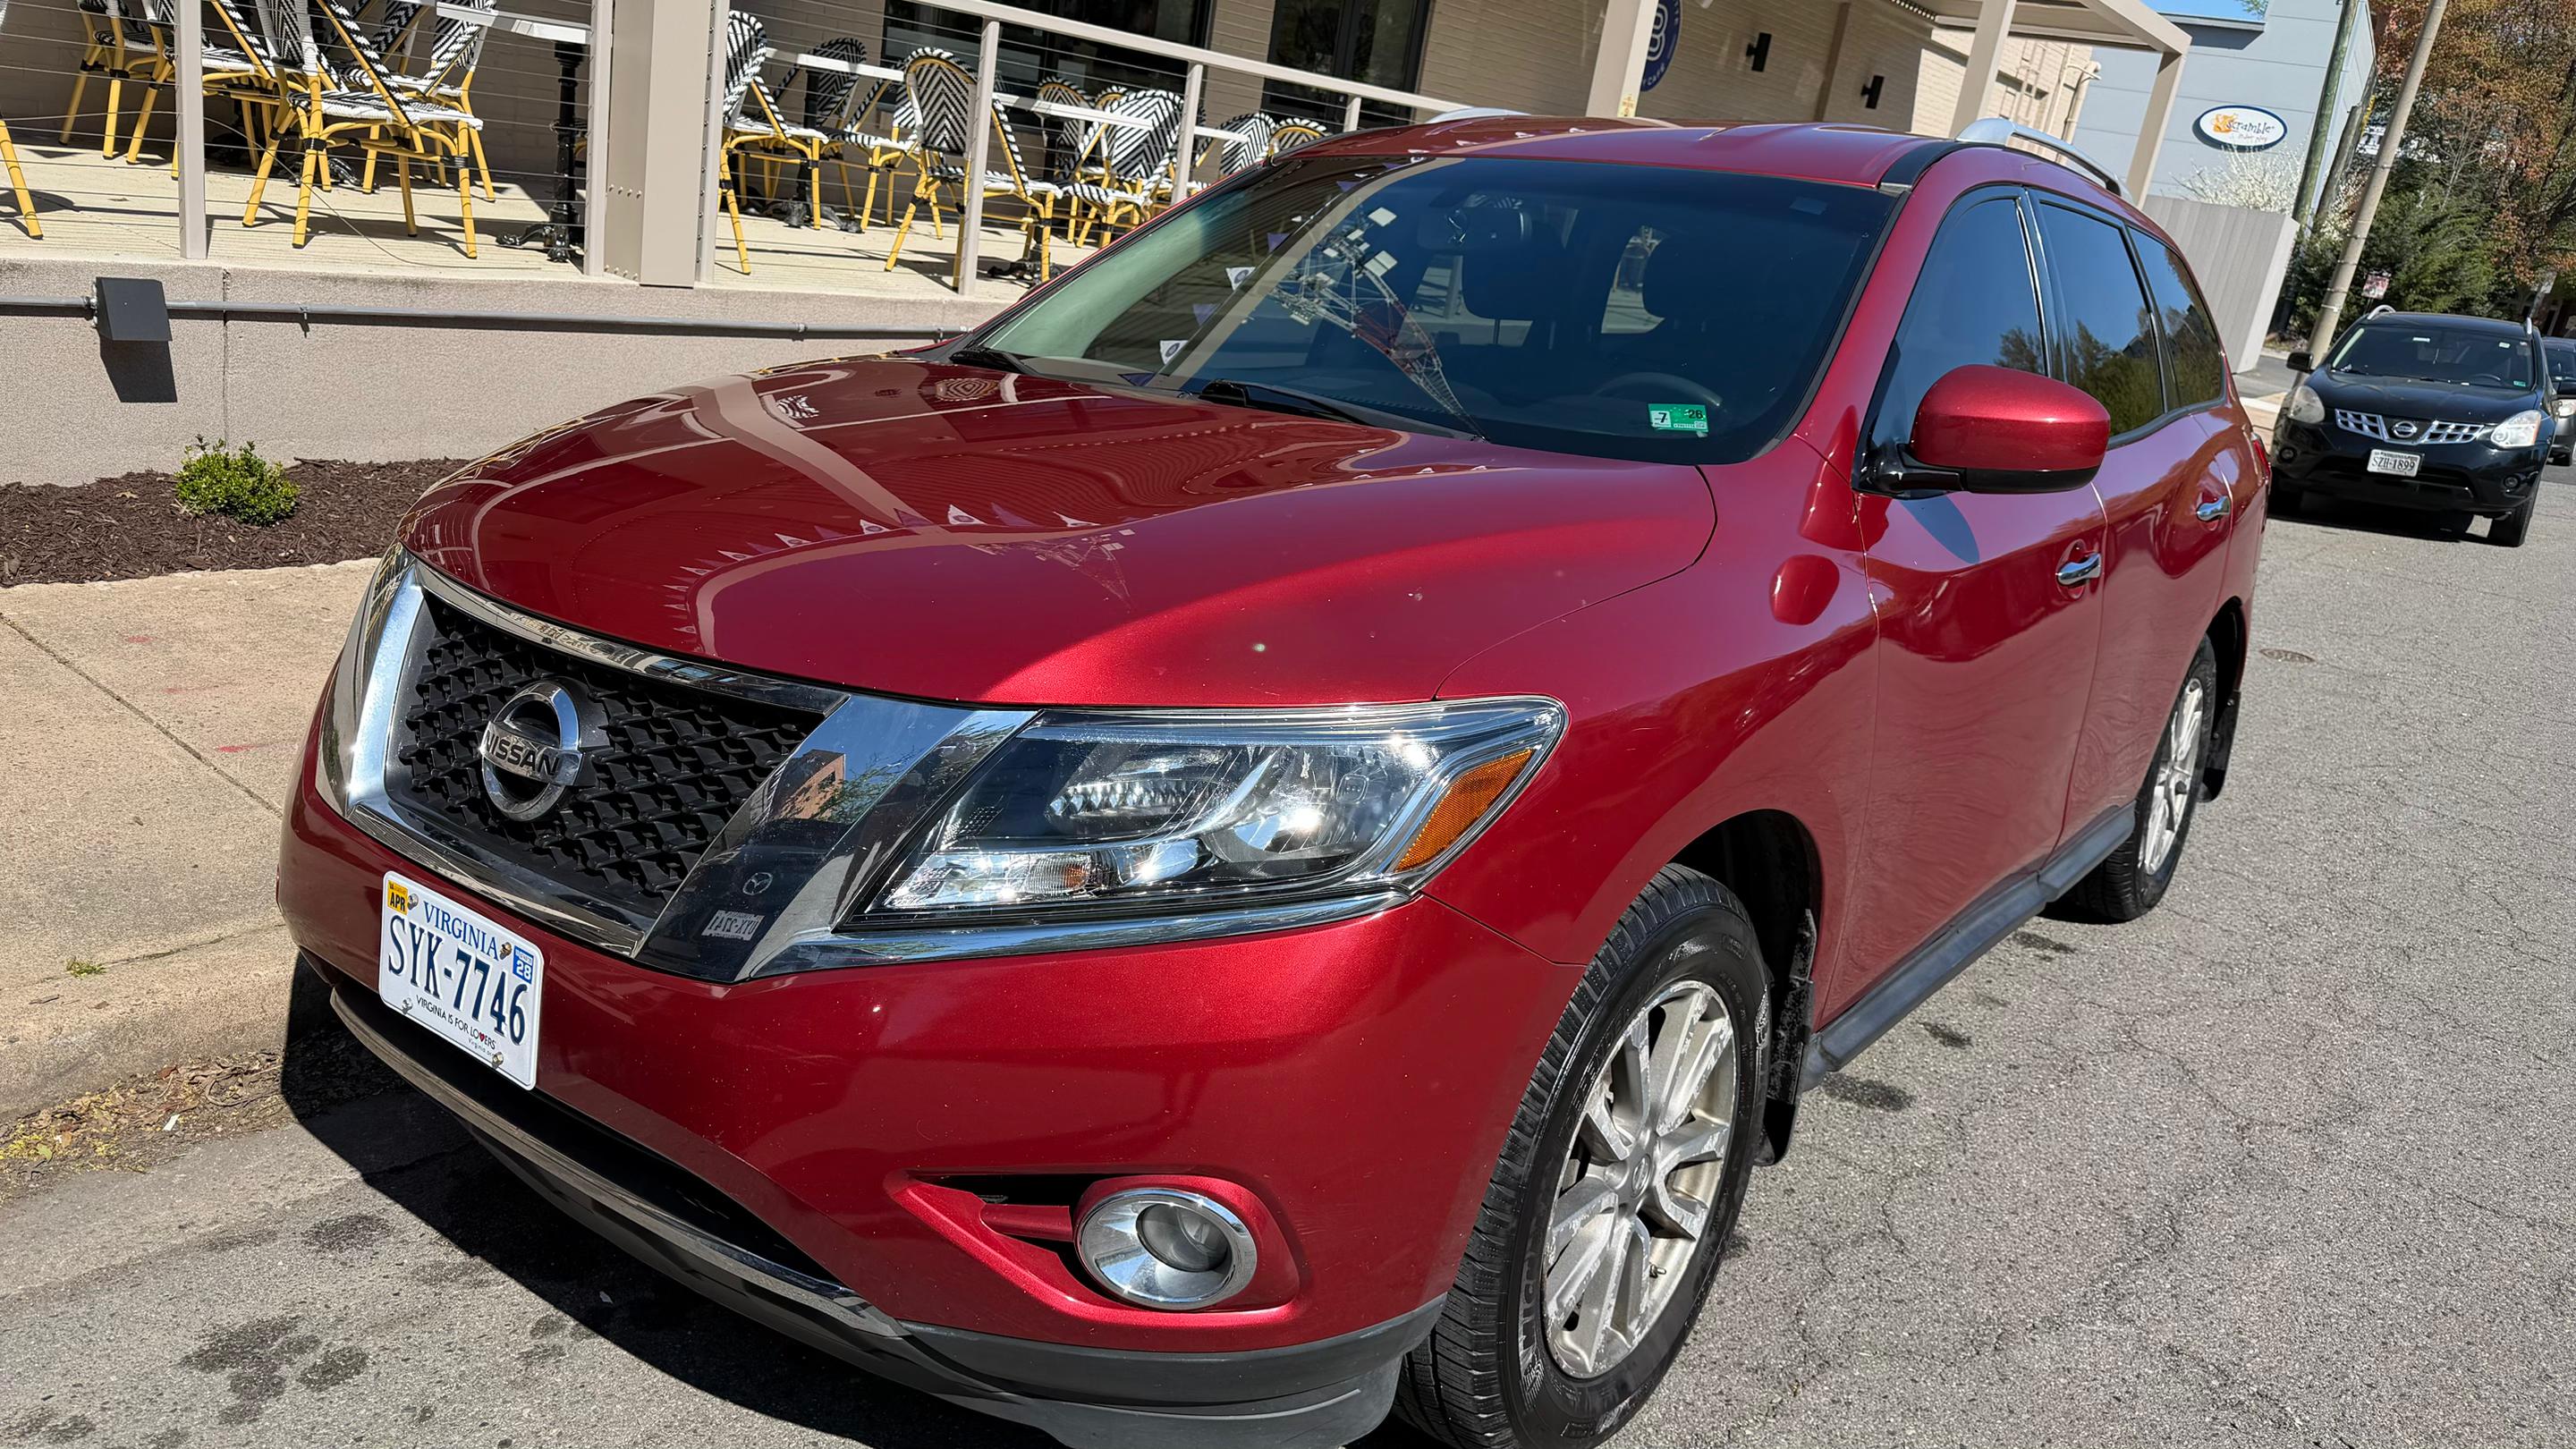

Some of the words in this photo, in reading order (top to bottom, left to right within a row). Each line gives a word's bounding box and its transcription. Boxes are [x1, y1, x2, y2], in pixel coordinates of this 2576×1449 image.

[1688, 409, 1704, 419] 26
[486, 728, 560, 776] NISSAN
[389, 892, 406, 912] APR
[422, 900, 500, 962] VIRGINIA
[388, 914, 528, 1046] SYK-7746
[516, 959, 532, 980] 28
[416, 994, 447, 1021] VIRGINIA
[447, 1013, 453, 1025] IS
[454, 1017, 470, 1035] FOR
